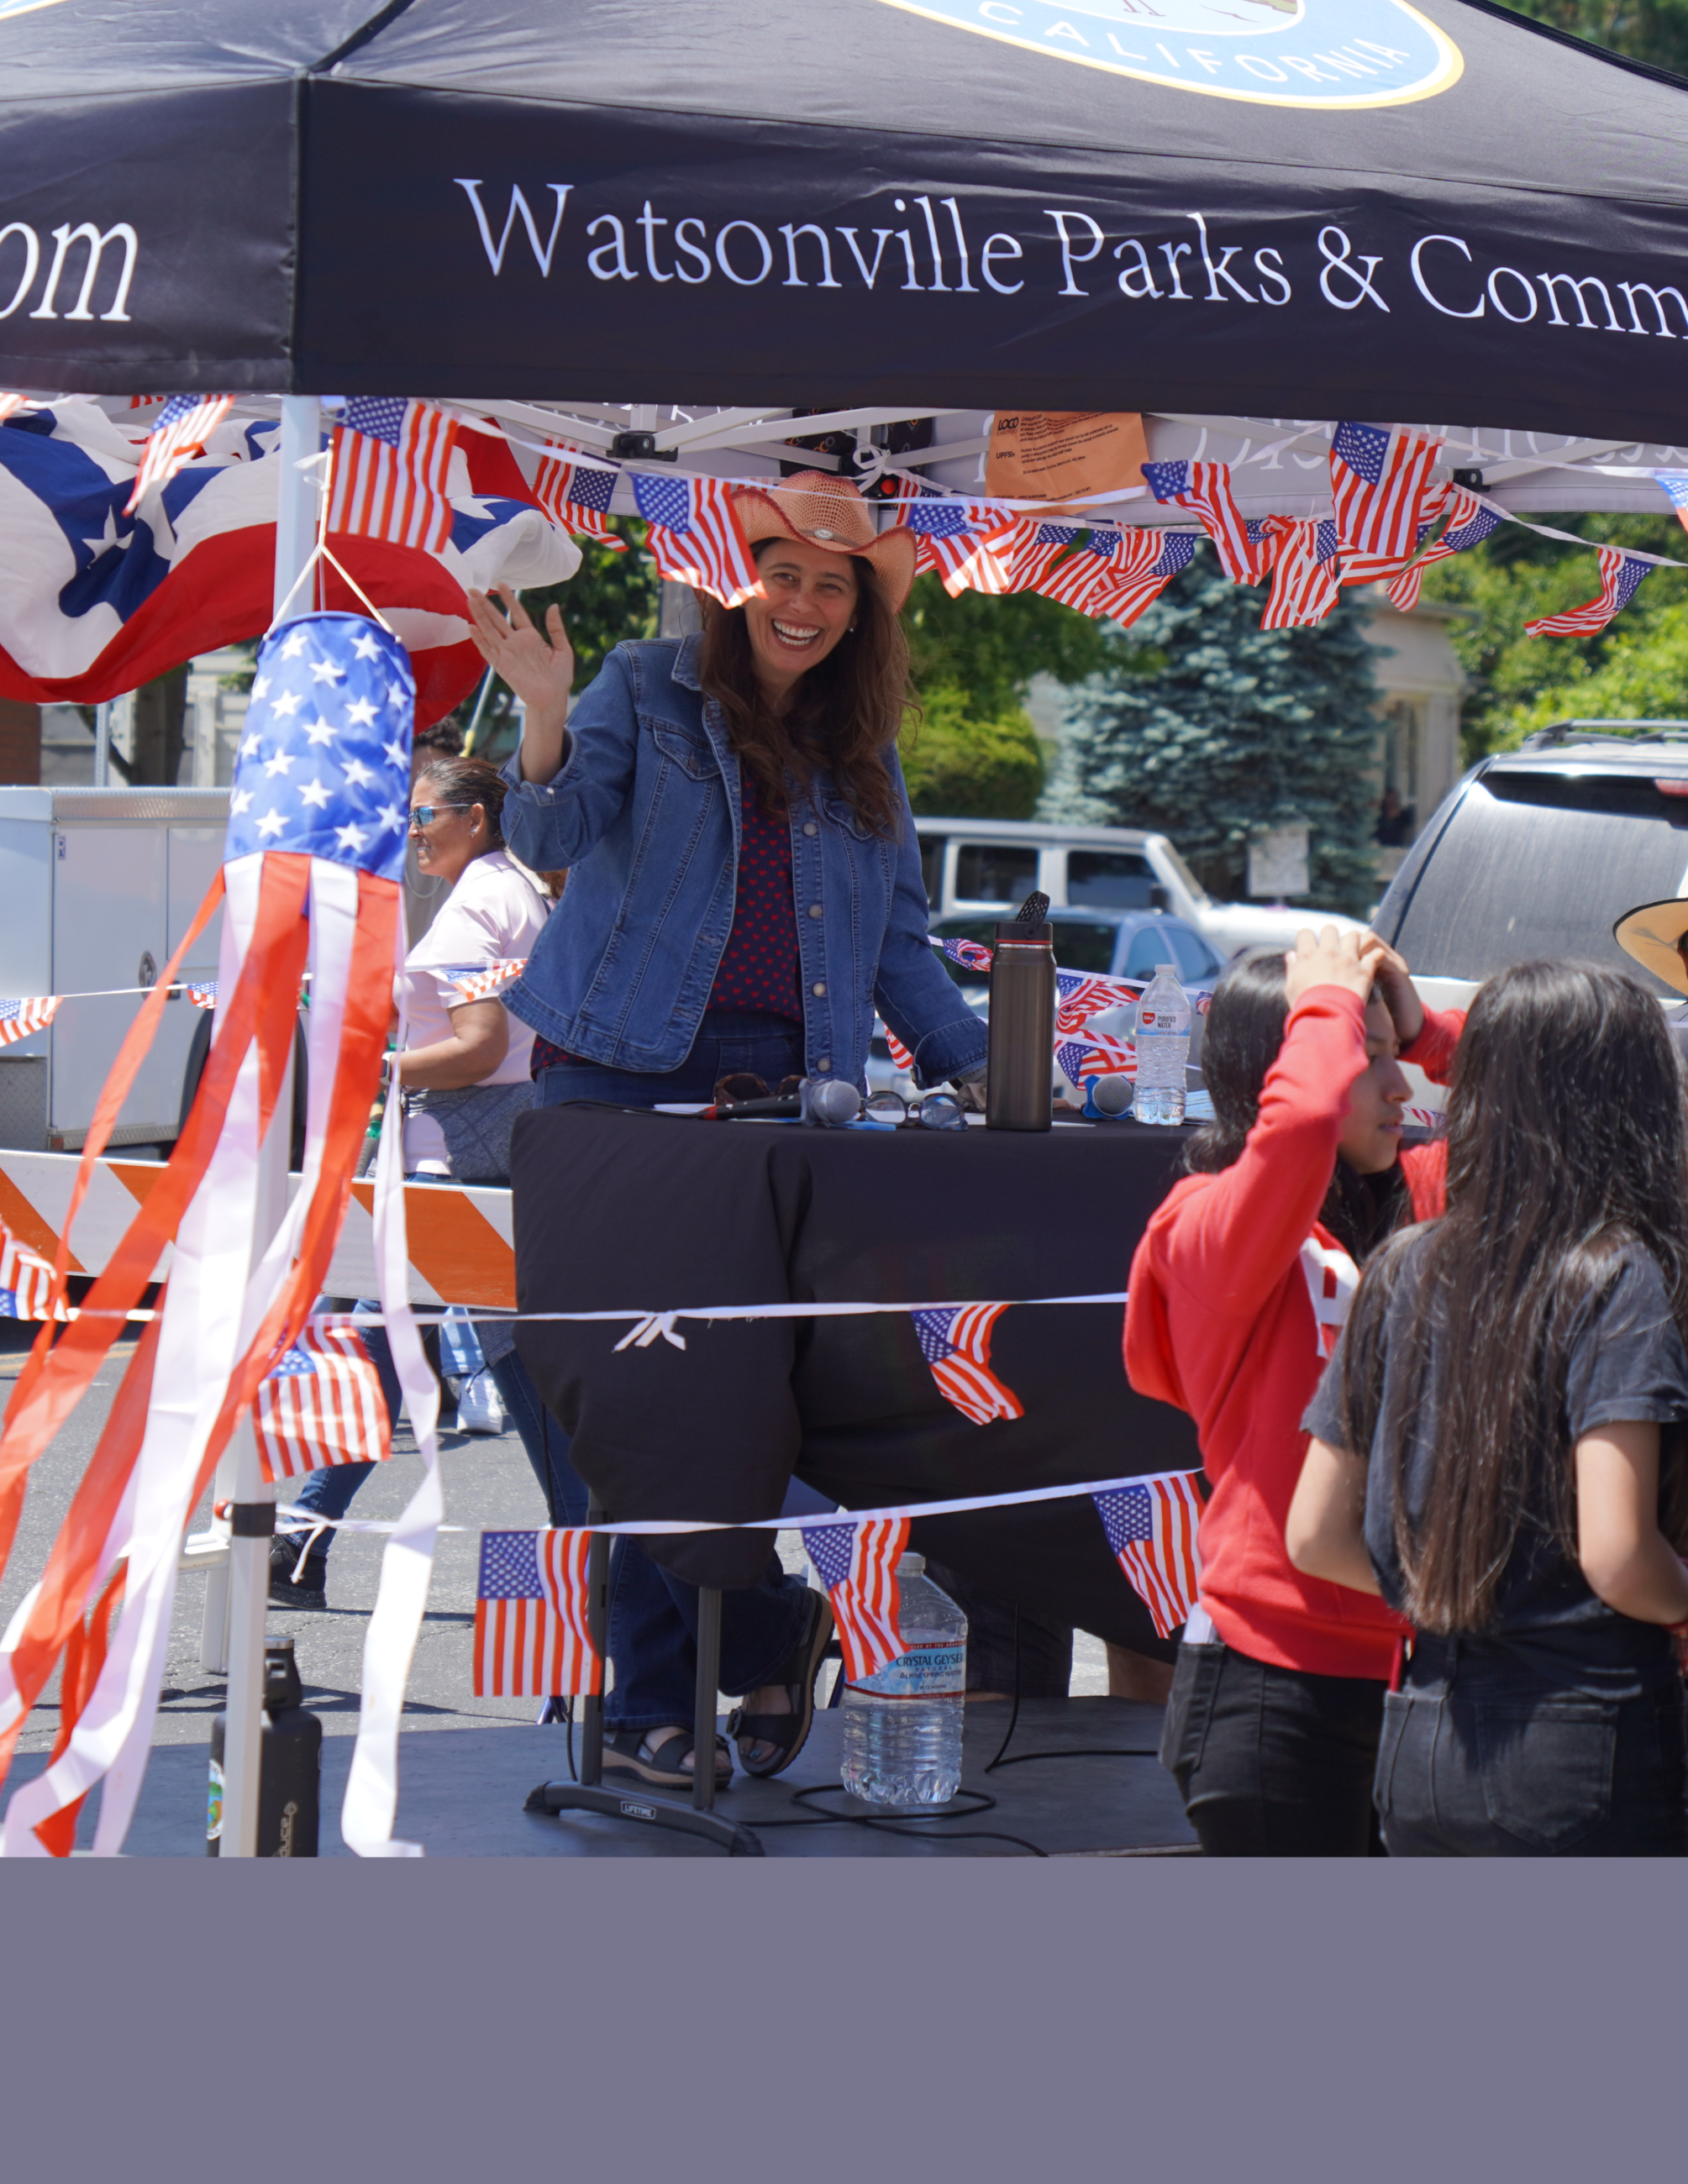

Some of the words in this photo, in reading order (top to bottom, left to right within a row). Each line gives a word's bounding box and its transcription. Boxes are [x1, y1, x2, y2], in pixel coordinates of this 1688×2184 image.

[978, 1, 1410, 81] CALIFORNIA
[458, 180, 1023, 295] Watsonville
[1044, 211, 1291, 305] Parks
[1318, 226, 1390, 312] &
[998, 417, 1019, 430] LOCO
[996, 450, 1016, 459] UPF50+
[896, 1656, 932, 1667] CRYSTAL
[934, 1654, 964, 1665] GEYSER
[624, 1803, 652, 1817] LIFETIME
